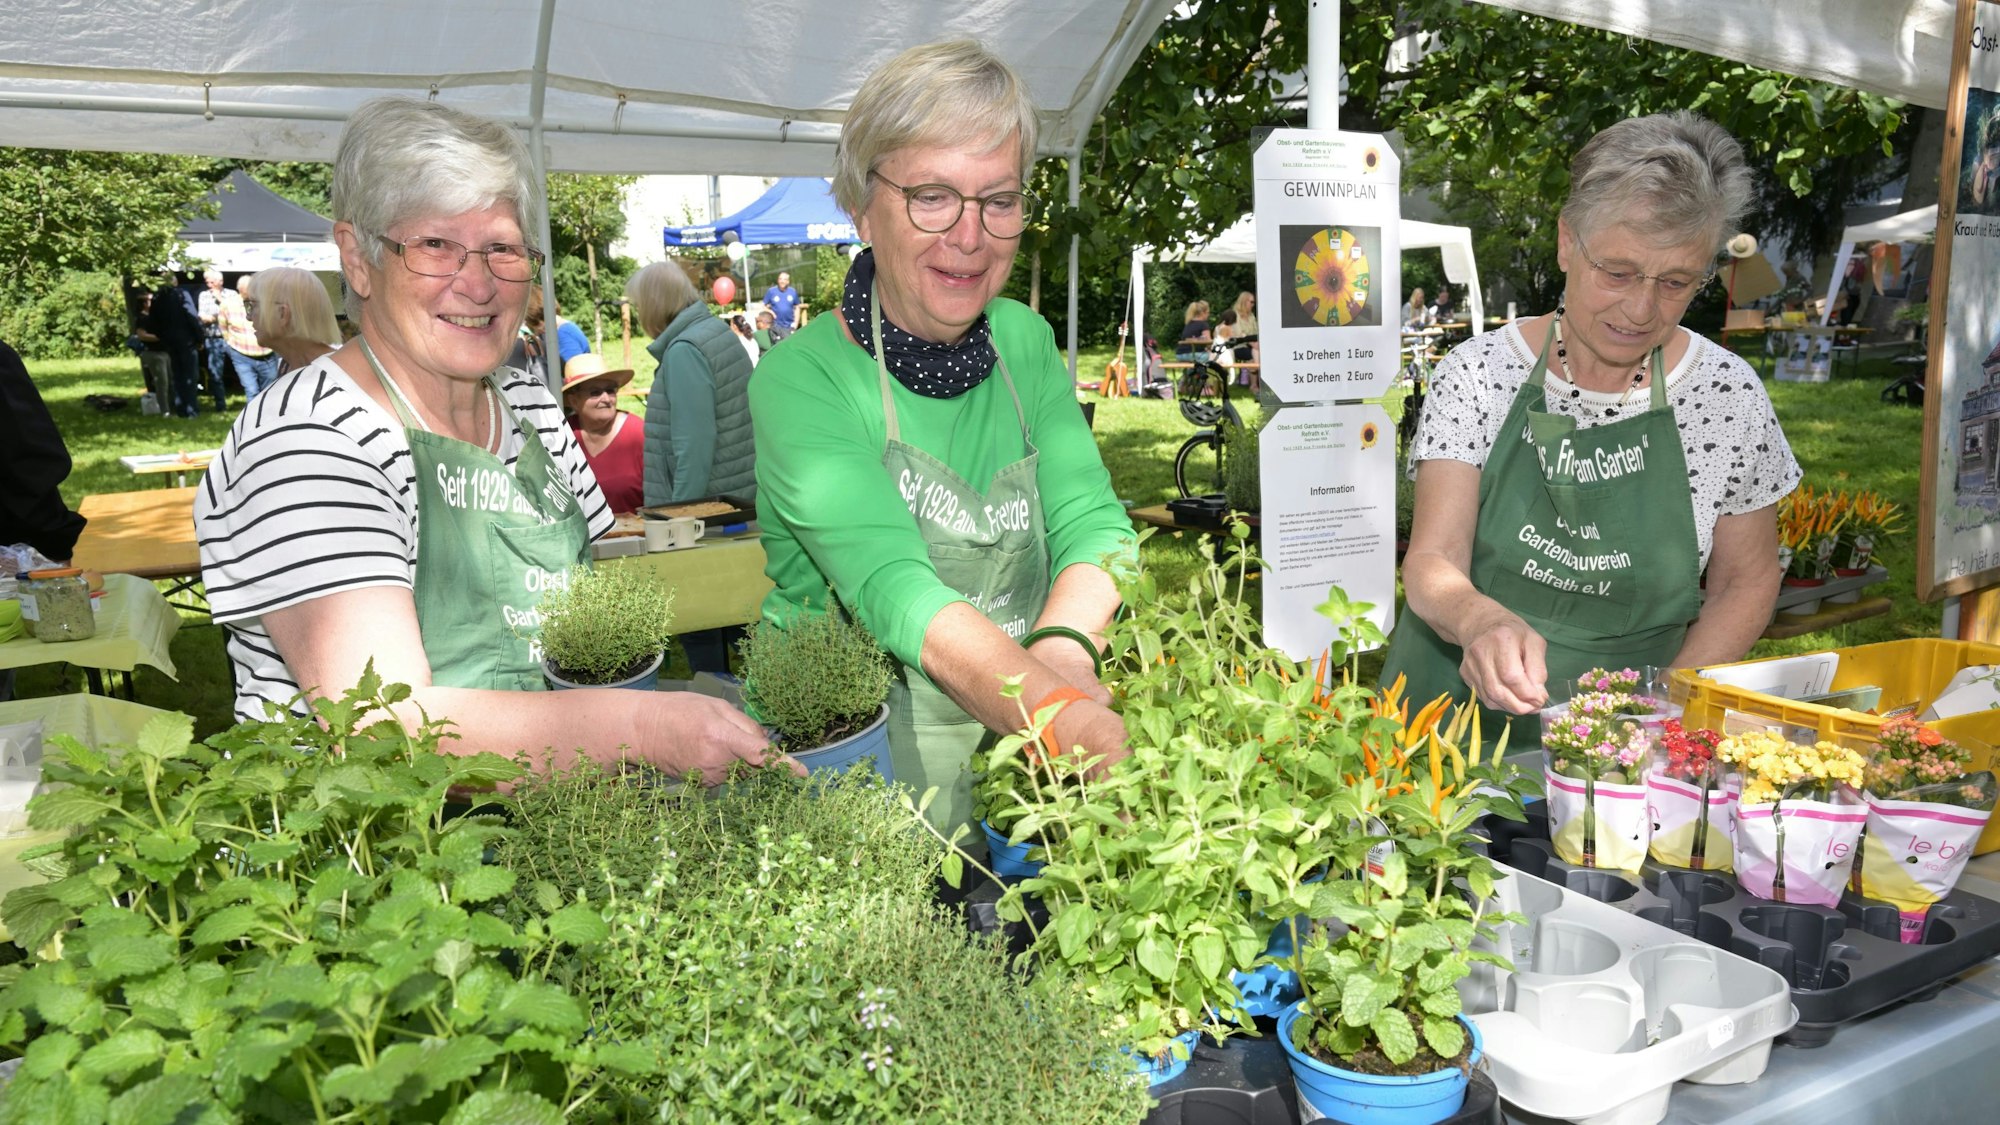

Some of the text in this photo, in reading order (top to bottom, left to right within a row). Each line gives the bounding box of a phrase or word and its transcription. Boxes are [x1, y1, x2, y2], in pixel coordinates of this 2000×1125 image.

[1284, 181, 1377, 200] GEWINNPLAN
[1954, 221, 1979, 236] Kraut
[1293, 348, 1374, 361] 1x Drehen 1 Euro
[1293, 371, 1374, 384] 3x Drehen 2 Euro
[1303, 422, 1344, 430] Gartenbauverein
[1574, 458, 1598, 483] am
[436, 462, 467, 509] Seit
[471, 468, 510, 512] 1929
[1310, 484, 1355, 496] Information
[920, 480, 959, 528] 1929
[1580, 521, 1601, 540] und
[1518, 524, 1632, 571] Gartenbauverein
[1521, 559, 1579, 592] Refrath
[1826, 836, 1849, 858] le
[1908, 834, 1932, 854] le
